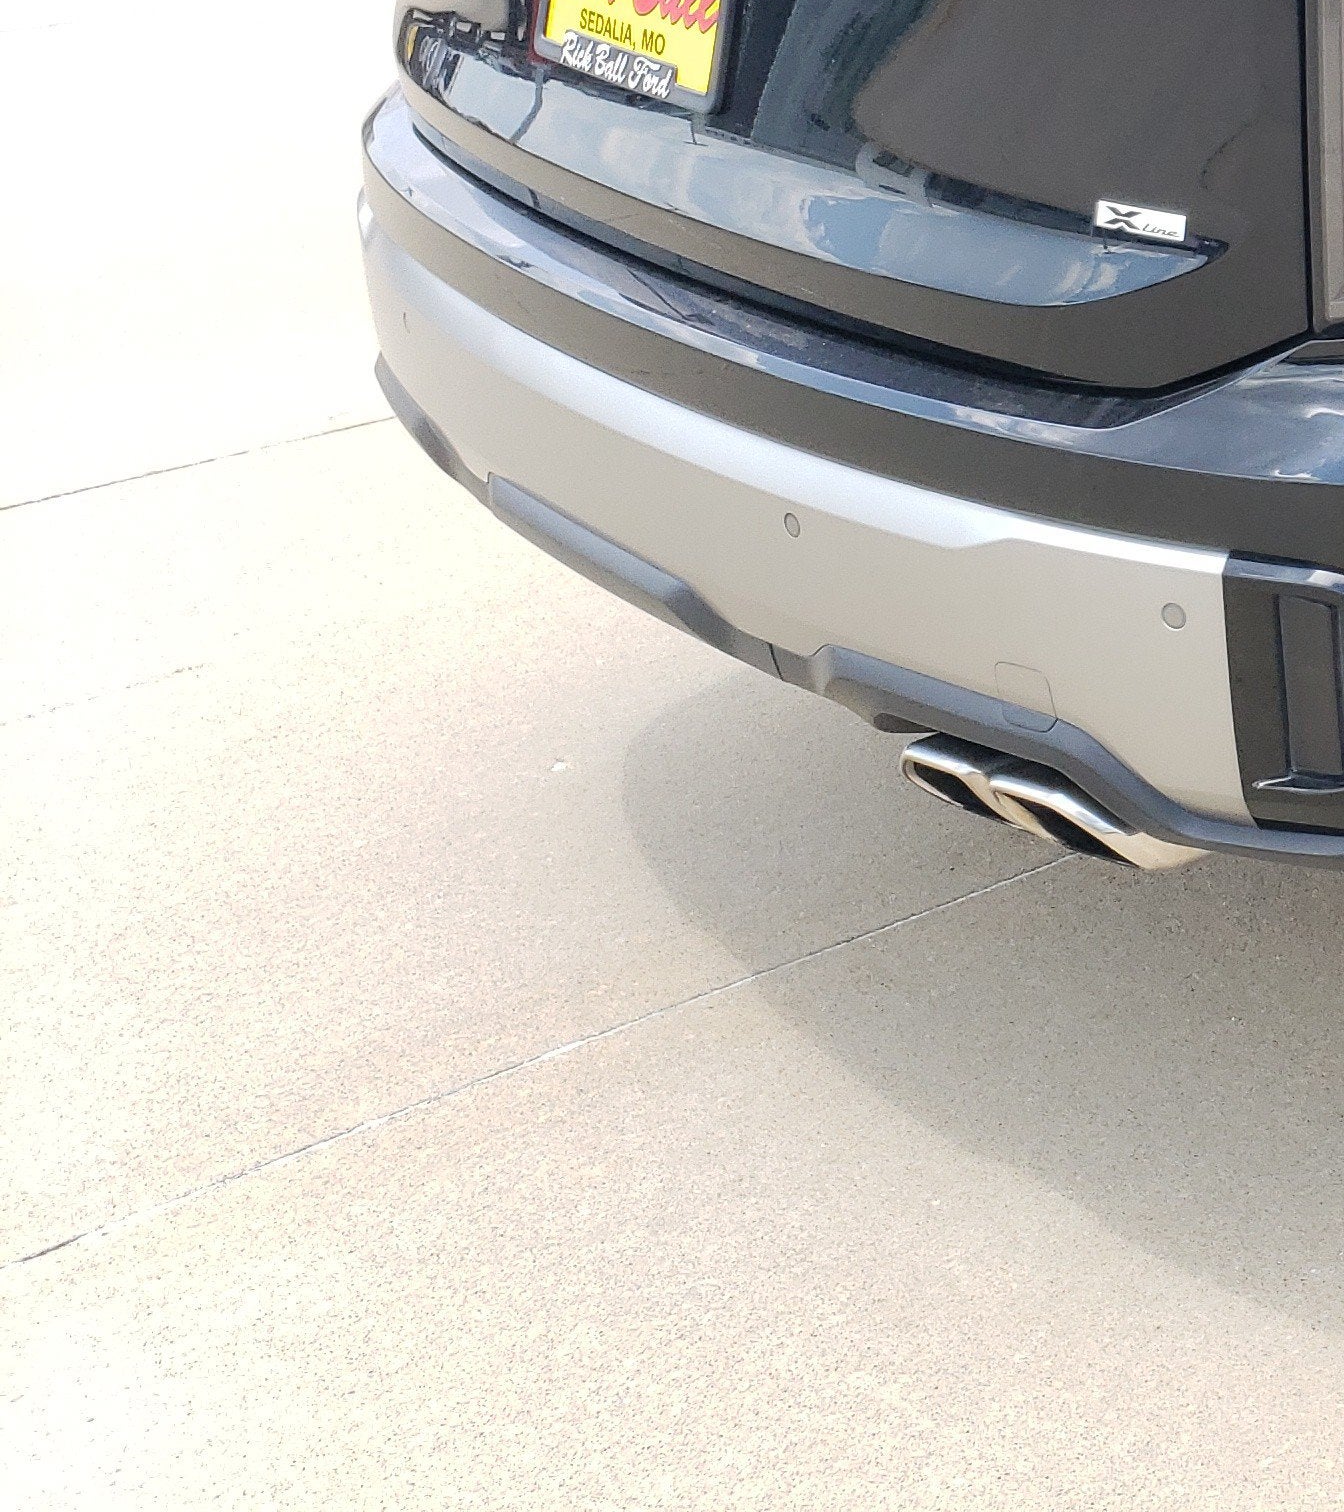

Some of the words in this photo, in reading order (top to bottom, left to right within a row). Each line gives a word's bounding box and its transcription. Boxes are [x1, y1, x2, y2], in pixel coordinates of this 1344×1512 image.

[579, 7, 636, 50] SEDALIA,
[640, 29, 666, 55] MO
[560, 30, 594, 72] Rick
[593, 43, 628, 85] Ball
[627, 55, 673, 99] Ford
